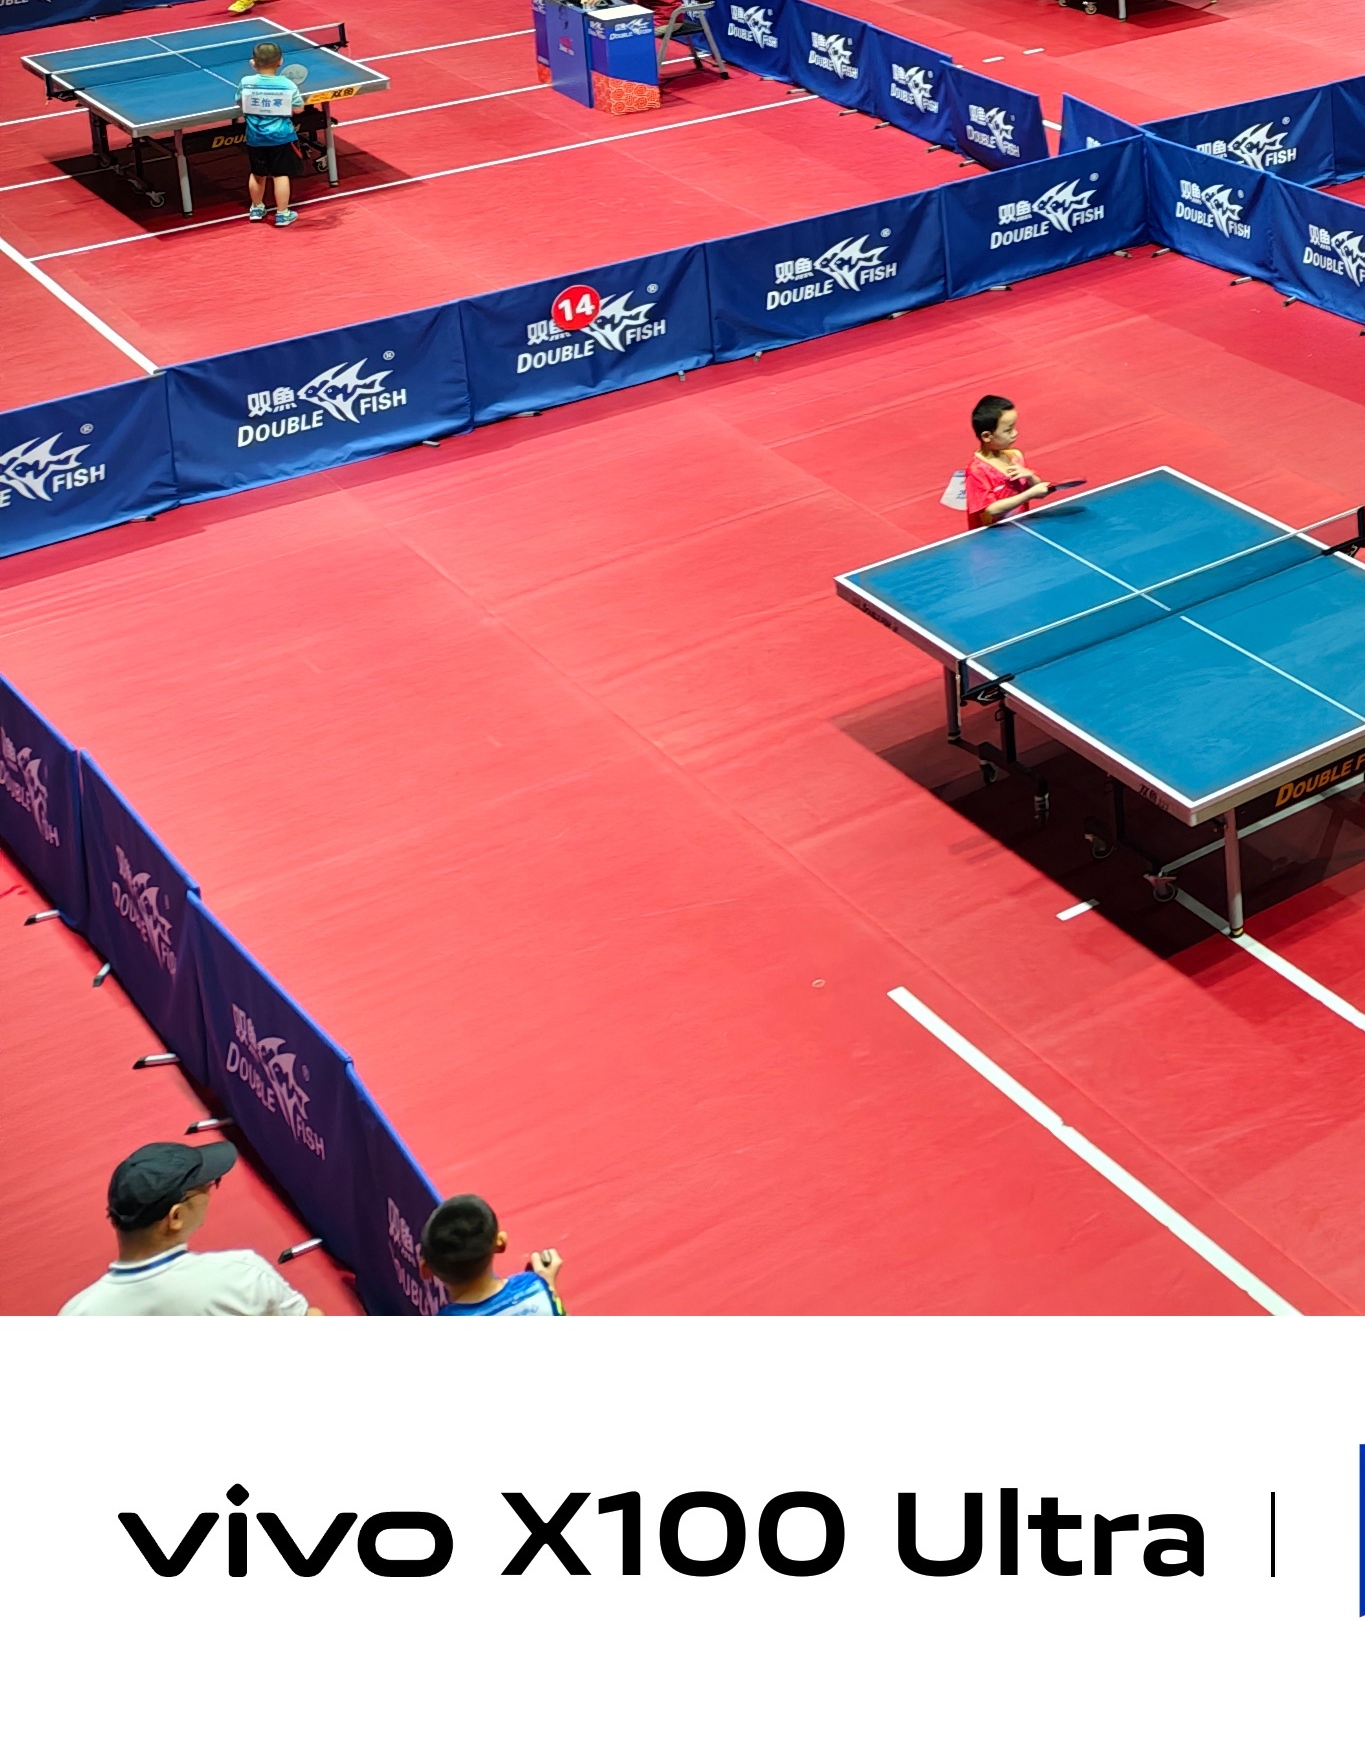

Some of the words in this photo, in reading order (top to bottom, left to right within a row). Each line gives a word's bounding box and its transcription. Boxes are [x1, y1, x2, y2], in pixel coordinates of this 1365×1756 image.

[990, 220, 1050, 249] DOUBLE
[1072, 205, 1104, 226] FISH
[1303, 244, 1344, 275] DOUBLE
[558, 299, 596, 321] 14
[766, 279, 834, 310] DOUBLE
[860, 262, 897, 285] FISH
[517, 339, 595, 373] DOUBLE
[626, 319, 666, 345] FISH
[238, 405, 324, 447] DOUBLE
[360, 388, 407, 415] FISH
[1275, 757, 1353, 809] DOUBLE
[226, 1041, 276, 1113] DOUBLE
[296, 1114, 325, 1160] FISH
